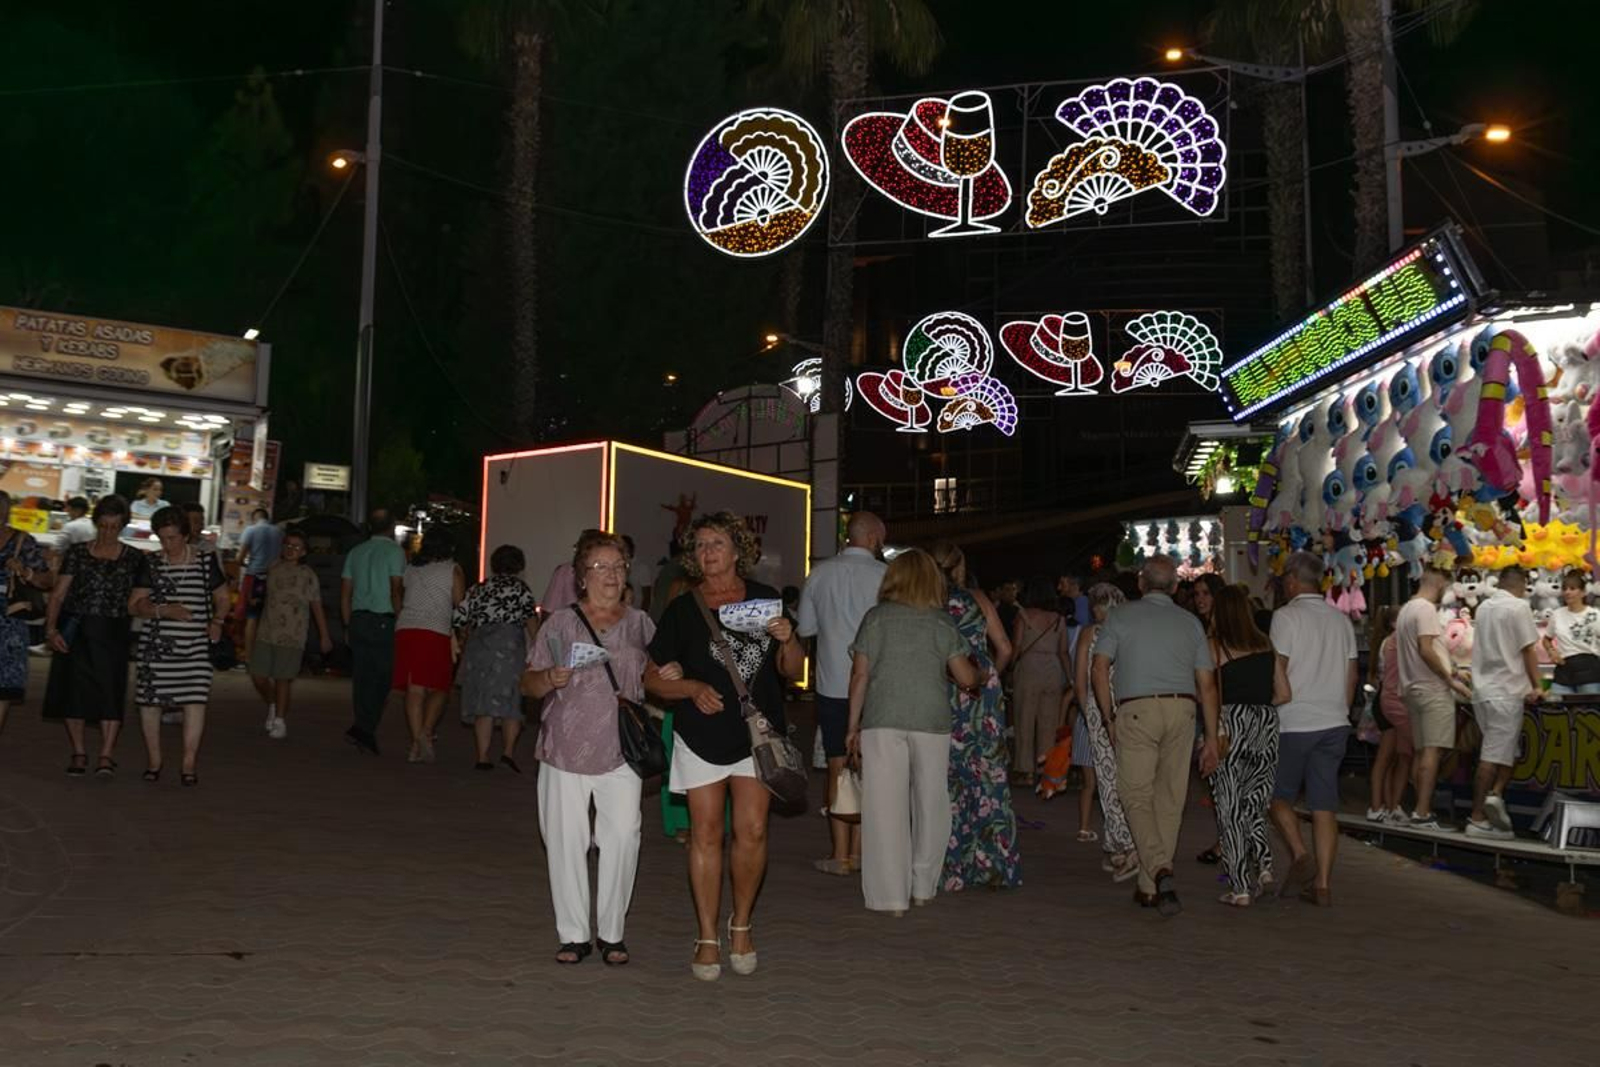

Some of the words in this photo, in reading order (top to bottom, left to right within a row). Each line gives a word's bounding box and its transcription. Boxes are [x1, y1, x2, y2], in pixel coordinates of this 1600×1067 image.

[16, 314, 86, 337] PATATAS
[93, 324, 153, 344] ASADAS
[13, 356, 94, 378] HERMANOS
